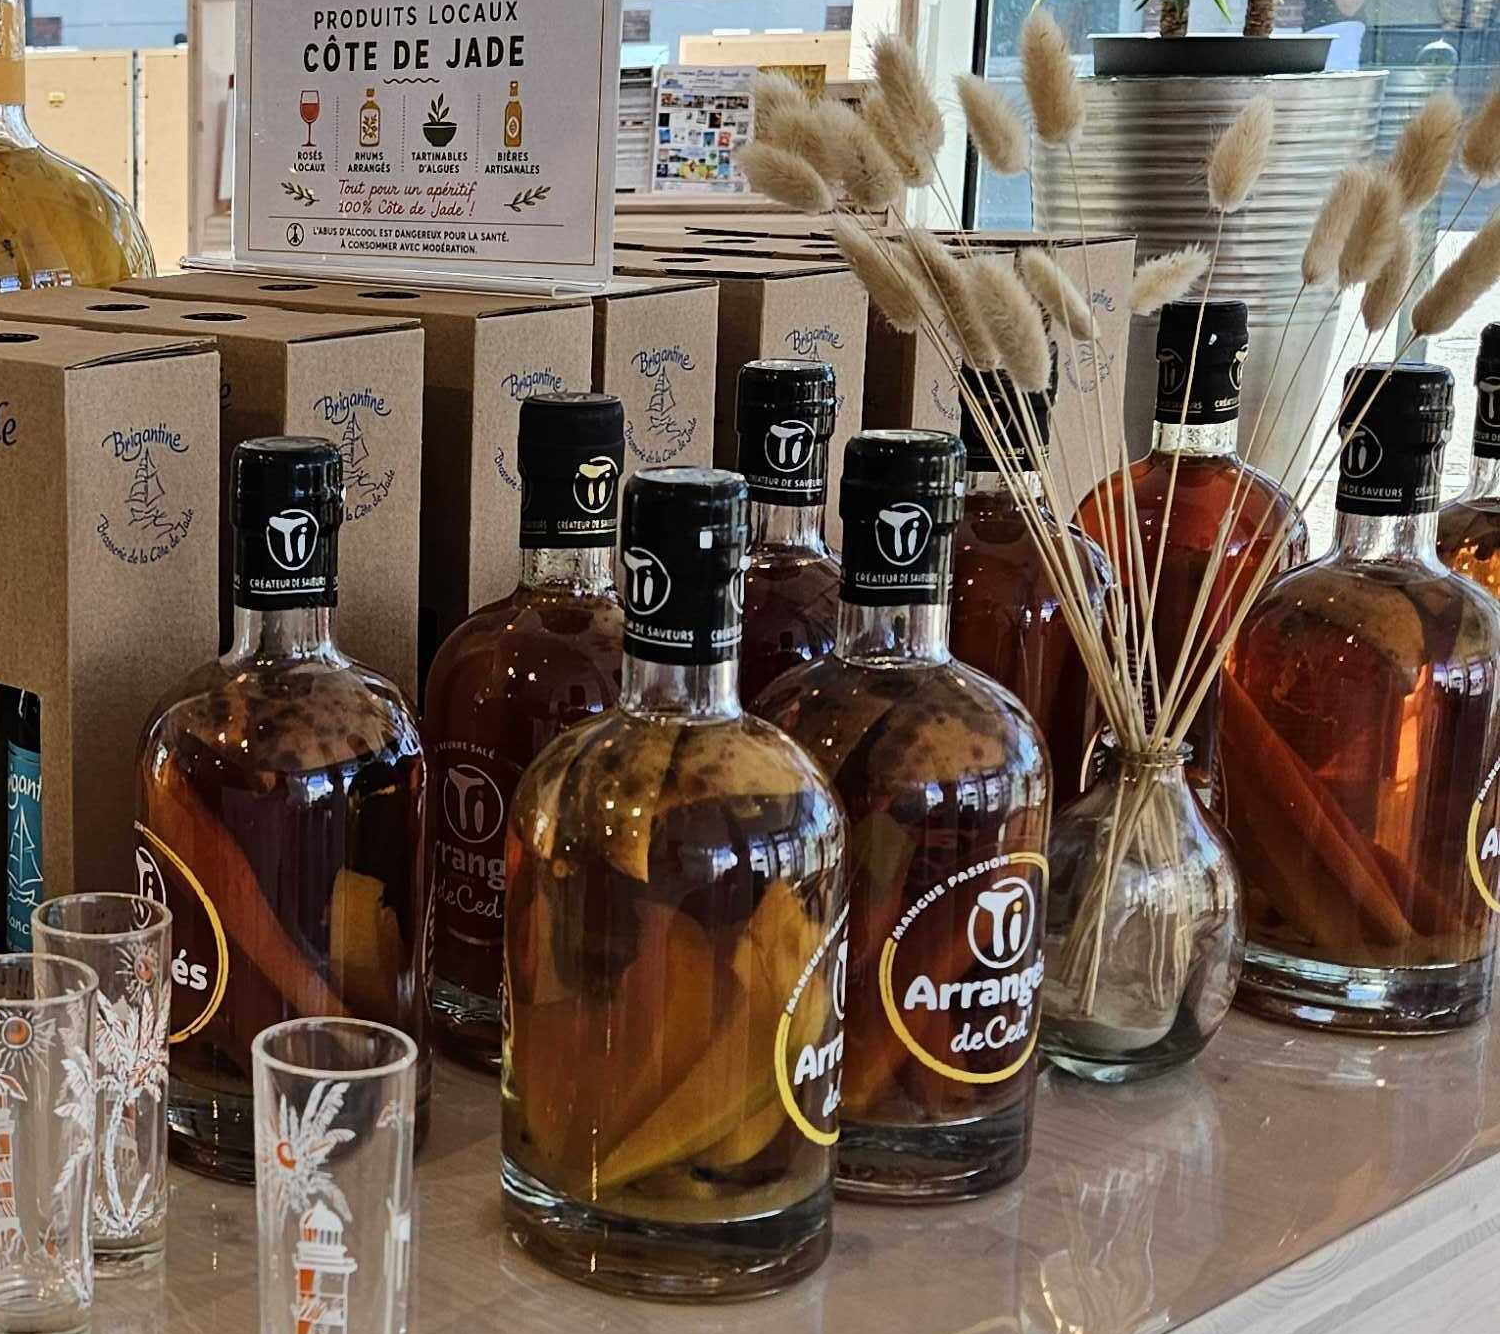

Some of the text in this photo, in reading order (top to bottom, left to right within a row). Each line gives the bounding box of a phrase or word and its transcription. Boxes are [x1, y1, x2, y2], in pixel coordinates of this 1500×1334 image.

[314, 0, 518, 30] PRODUITS LOCAUX
[303, 34, 524, 73] CÔTE DE JADE
[297, 151, 323, 161] ROSÉS
[355, 151, 384, 161] RHUMS
[411, 151, 468, 162] TARTINABLES
[497, 150, 529, 162] BIÈRES
[293, 163, 325, 173] LOCAUX
[348, 162, 391, 173] ARRANGÉS
[419, 163, 460, 174] D'ALGUES
[484, 164, 540, 175] ARTISANALES
[338, 179, 478, 203] Tout pour un apéritif
[338, 200, 475, 217] 100% Côte de Jade !
[312, 226, 509, 242] L'ABUS D'ALCOOL EST DANGEREUX POUR LA SANTÉ.
[349, 240, 397, 251] CONSOMMER
[400, 242, 420, 252] AVEC
[785, 324, 844, 354] Brigantine
[631, 345, 696, 377] Brigantine
[500, 368, 568, 401] Brigantine
[313, 389, 392, 424] Brigantine
[102, 423, 189, 462] Brigantine
[770, 424, 806, 464] Ti
[377, 468, 396, 497] Jade
[781, 478, 792, 488] DE
[1361, 487, 1403, 498] SAVEURS
[557, 519, 590, 530] CRÉATEUR
[879, 509, 921, 557] Ti
[97, 514, 127, 561] Brasserie
[127, 548, 138, 564] de
[174, 508, 194, 538] Jade
[269, 516, 309, 562] Ti
[250, 575, 290, 588] CRÉATEUR
[292, 577, 300, 588] DE
[623, 550, 653, 606] Ti
[855, 570, 898, 583] CRÉATEUR
[900, 572, 908, 583] DE
[648, 625, 694, 642] SAVEURS
[448, 767, 485, 833] Ti
[892, 883, 946, 940] MANGUE
[947, 854, 1010, 888] PASSION
[977, 886, 1024, 957] Ti
